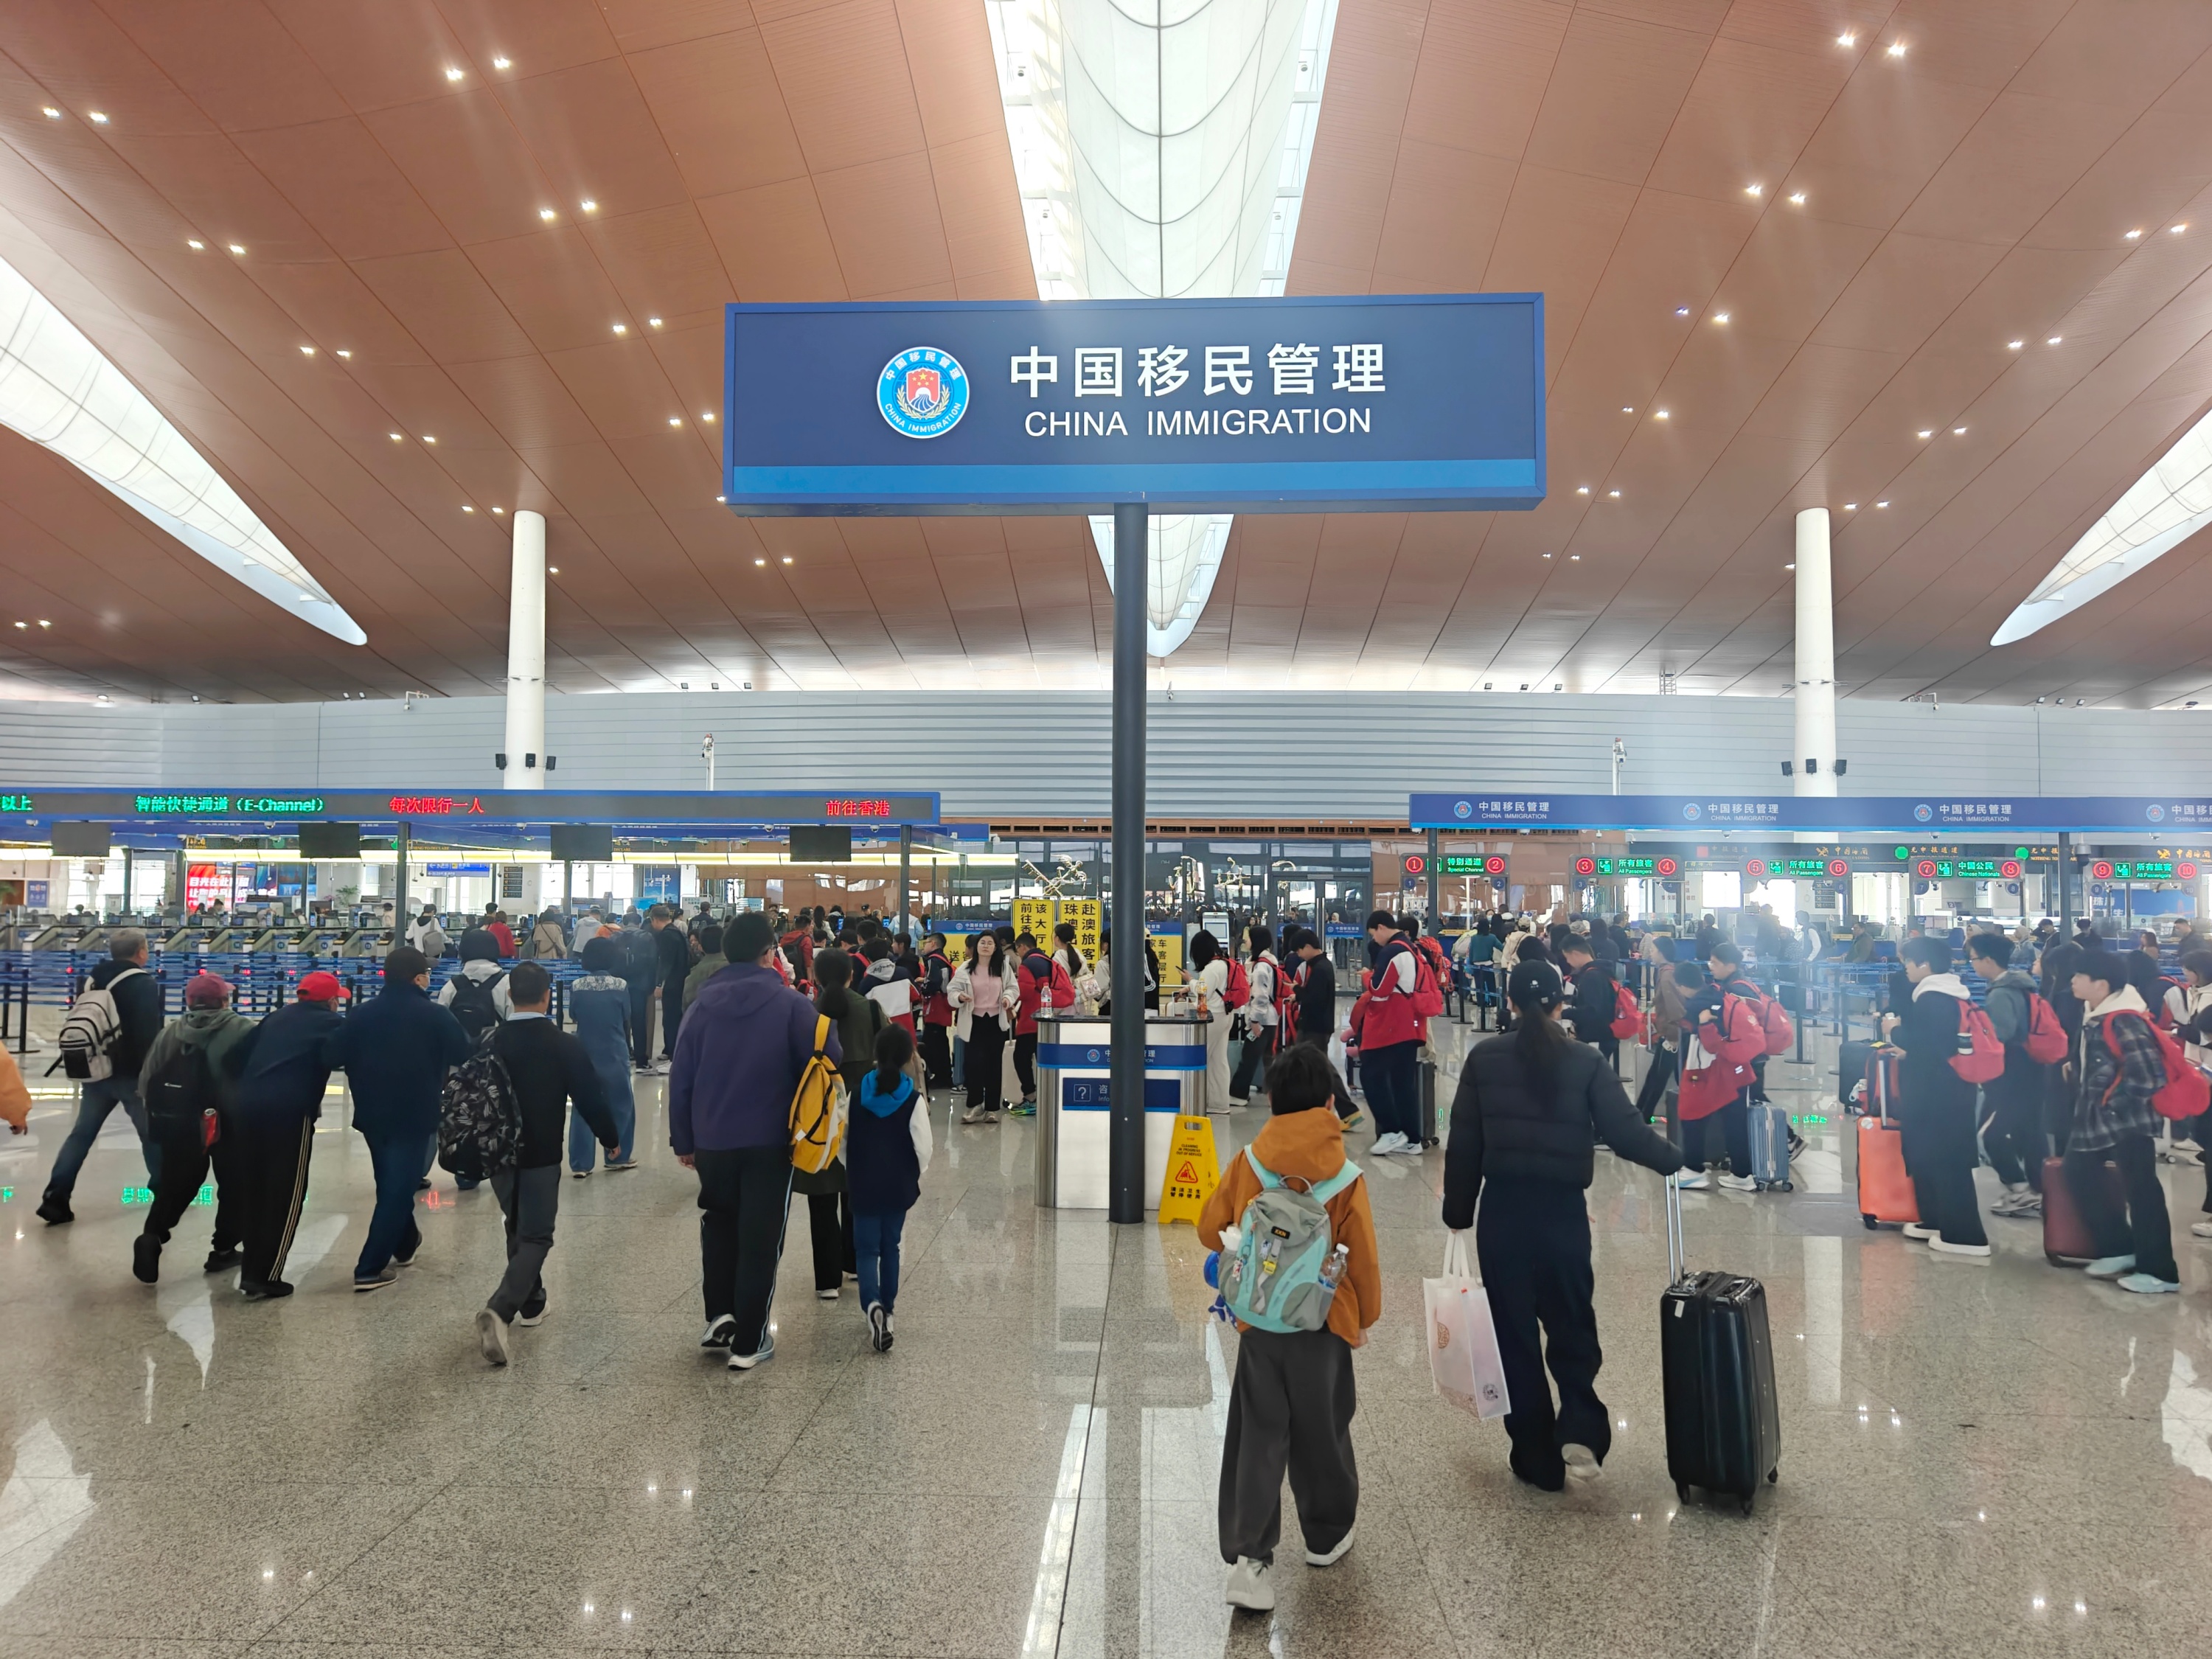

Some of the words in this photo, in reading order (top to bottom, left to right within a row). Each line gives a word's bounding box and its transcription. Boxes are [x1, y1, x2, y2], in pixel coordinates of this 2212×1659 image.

[1009, 342, 1387, 398] 中国移民管理
[885, 403, 907, 428] CHINA
[908, 402, 962, 433] IMMIGRATION
[1024, 411, 1129, 437] CHINA
[1147, 407, 1371, 437] IMMIGRATION
[389, 796, 484, 813] 每次限行一人
[826, 800, 890, 816] 前往香港
[1478, 801, 1550, 812] 中国移民管理
[1708, 803, 1779, 814] 中国移民管理
[1939, 804, 2012, 815] 中国移民管理
[1447, 858, 1482, 866] 特别通道
[1618, 859, 1653, 867] 所有旅客
[1789, 860, 1824, 869] 所有旅客
[1958, 861, 1994, 869] 中国公民
[2136, 863, 2172, 871] 所有旅客
